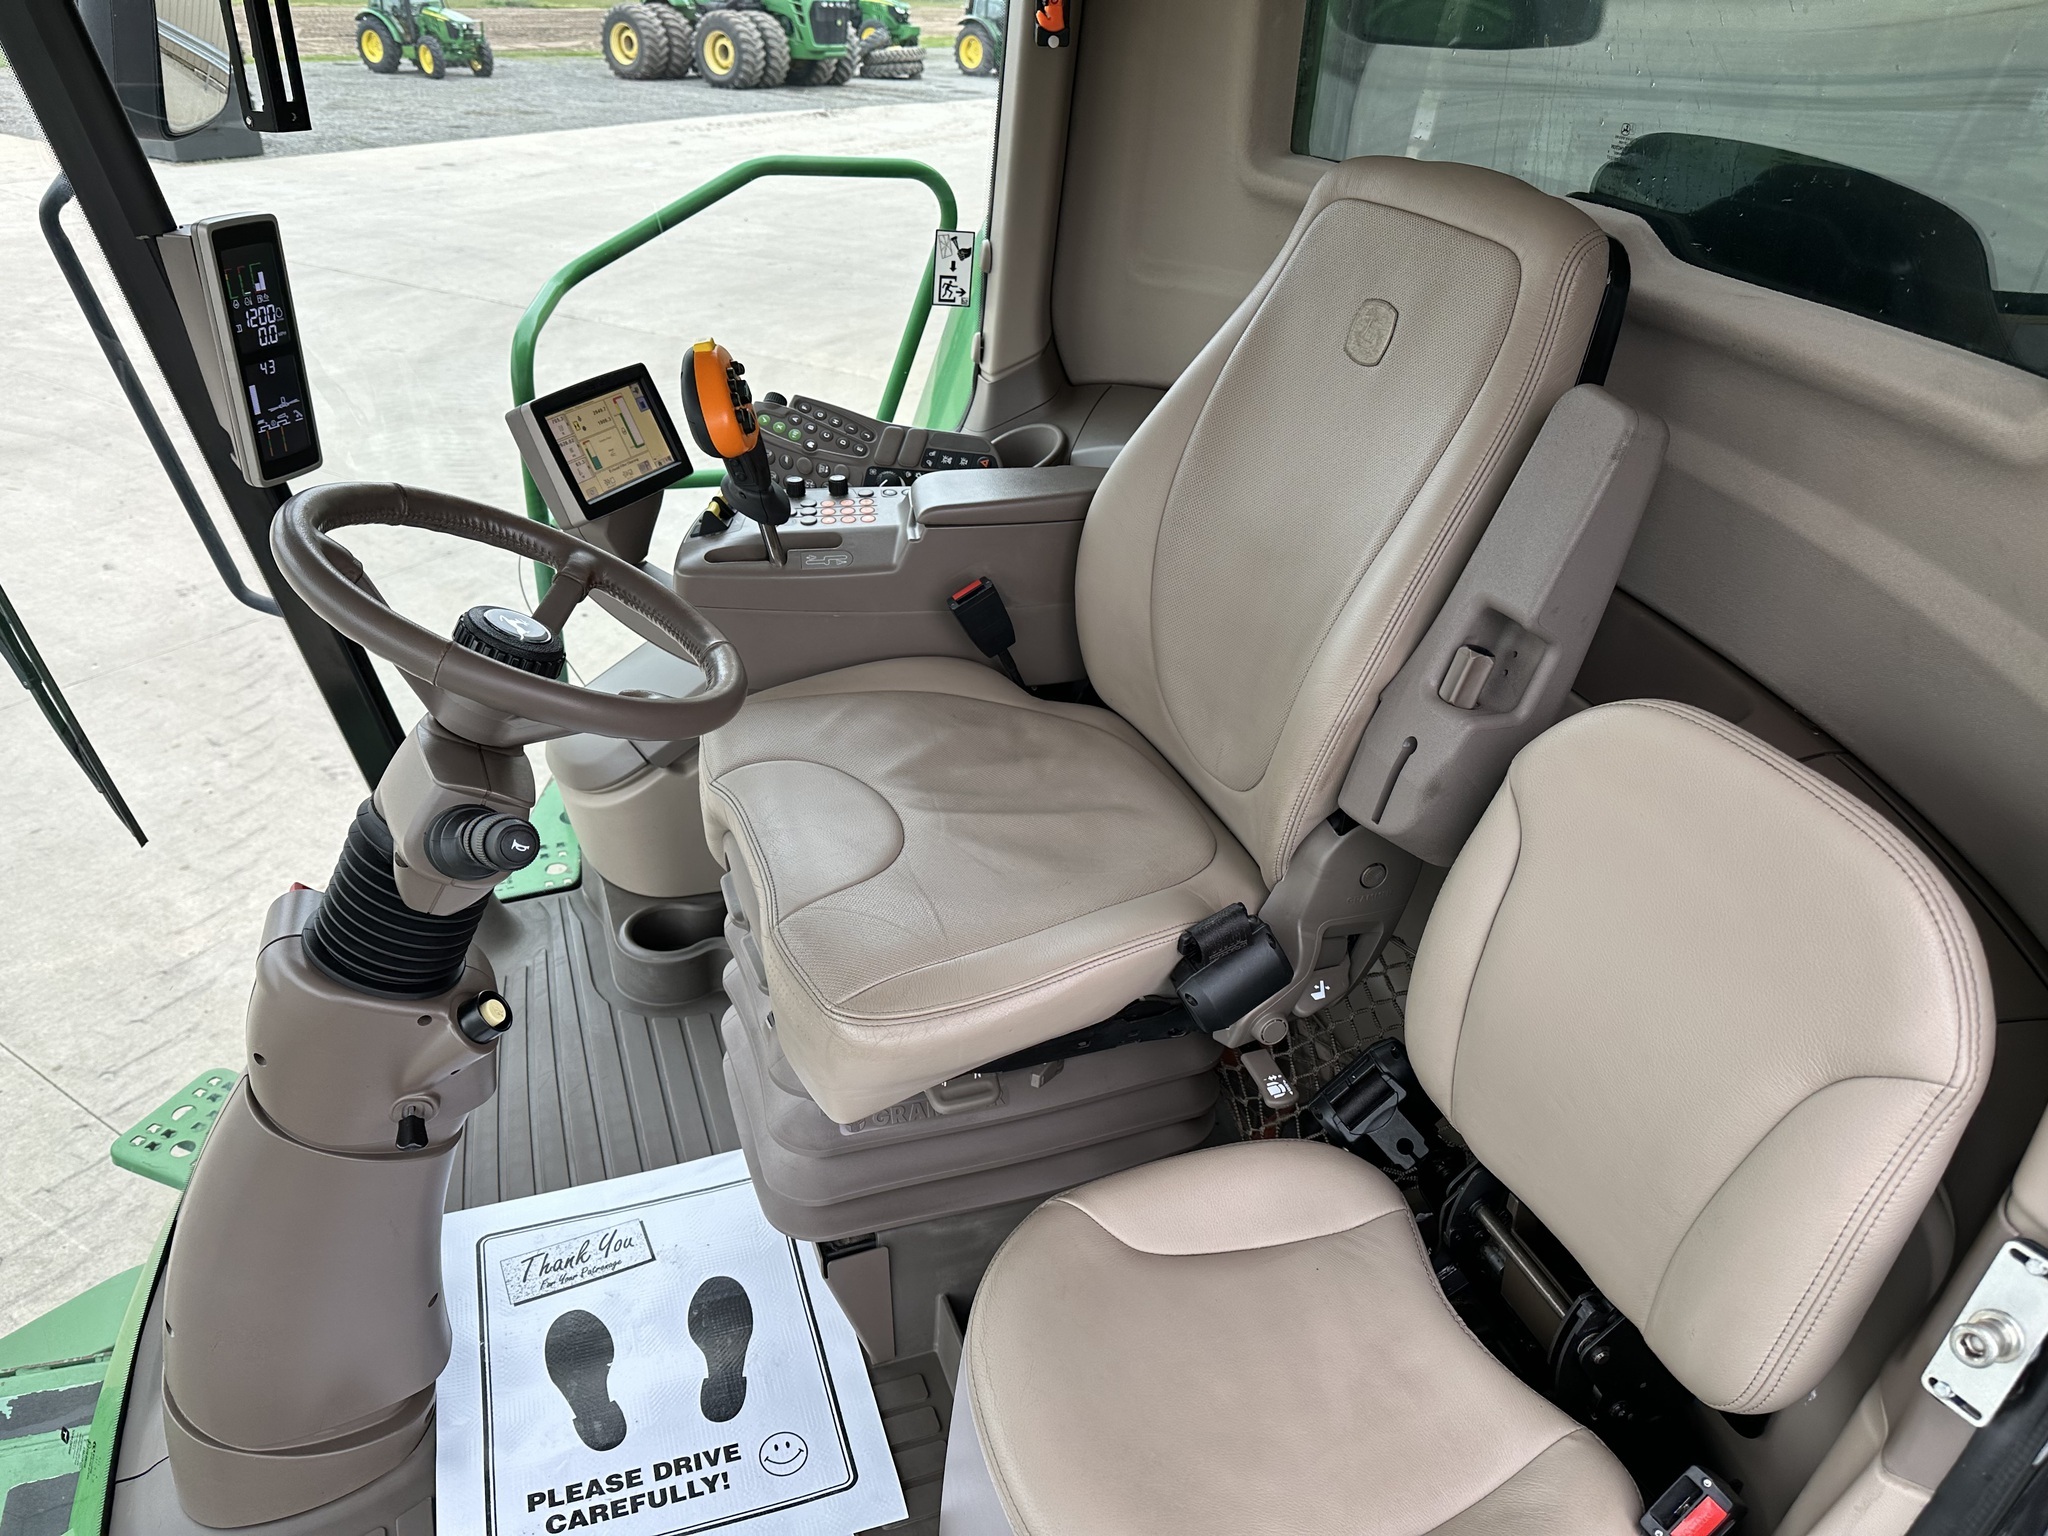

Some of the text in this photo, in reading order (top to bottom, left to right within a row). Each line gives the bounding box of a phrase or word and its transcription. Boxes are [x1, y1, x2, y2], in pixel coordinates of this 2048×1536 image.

[246, 304, 276, 328] 1200
[258, 324, 278, 346] 0.0
[260, 359, 276, 375] 43
[521, 1229, 634, 1283] Thank You
[540, 1278, 556, 1290] For
[559, 1273, 578, 1285] Your
[527, 1443, 742, 1513] PLEASE DRIVE
[545, 1471, 730, 1534] CAREFULLY!
